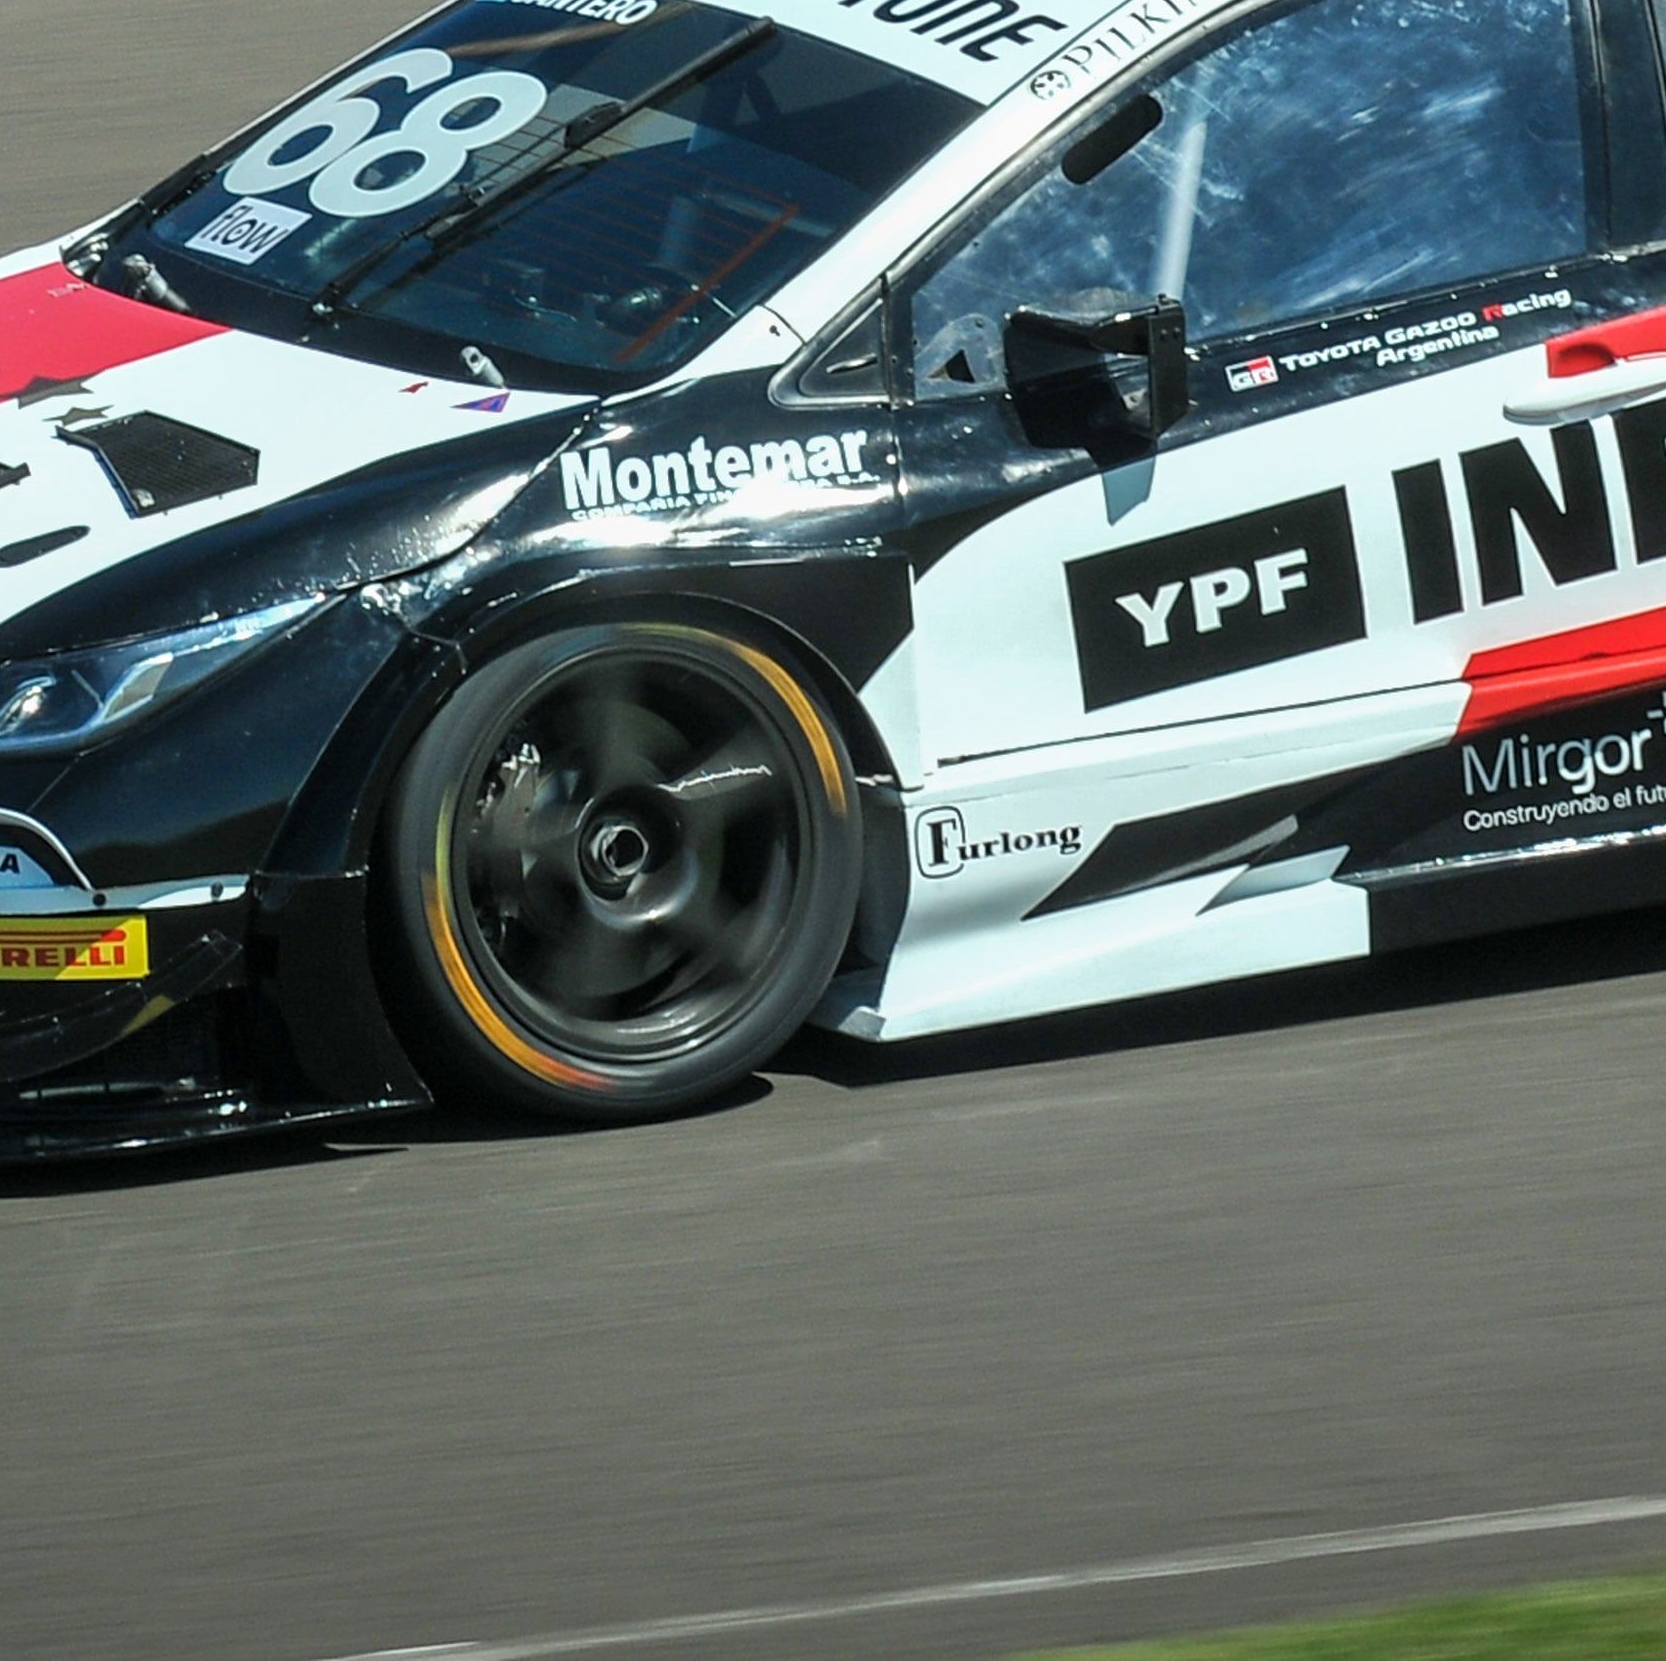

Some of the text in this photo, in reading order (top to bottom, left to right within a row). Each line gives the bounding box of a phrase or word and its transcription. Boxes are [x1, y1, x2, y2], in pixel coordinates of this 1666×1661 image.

[222, 48, 548, 218] 68
[201, 205, 288, 254] flow
[1279, 288, 1572, 372] TOYOTA GAZOO Racing
[1376, 325, 1500, 367] Argentina
[560, 429, 868, 510] Montemar
[1117, 548, 1312, 647] YPF
[1462, 727, 1652, 796] Mirgor
[926, 818, 1083, 867] Furlong
[1463, 792, 1610, 832] Construyendo
[1613, 787, 1632, 809] el
